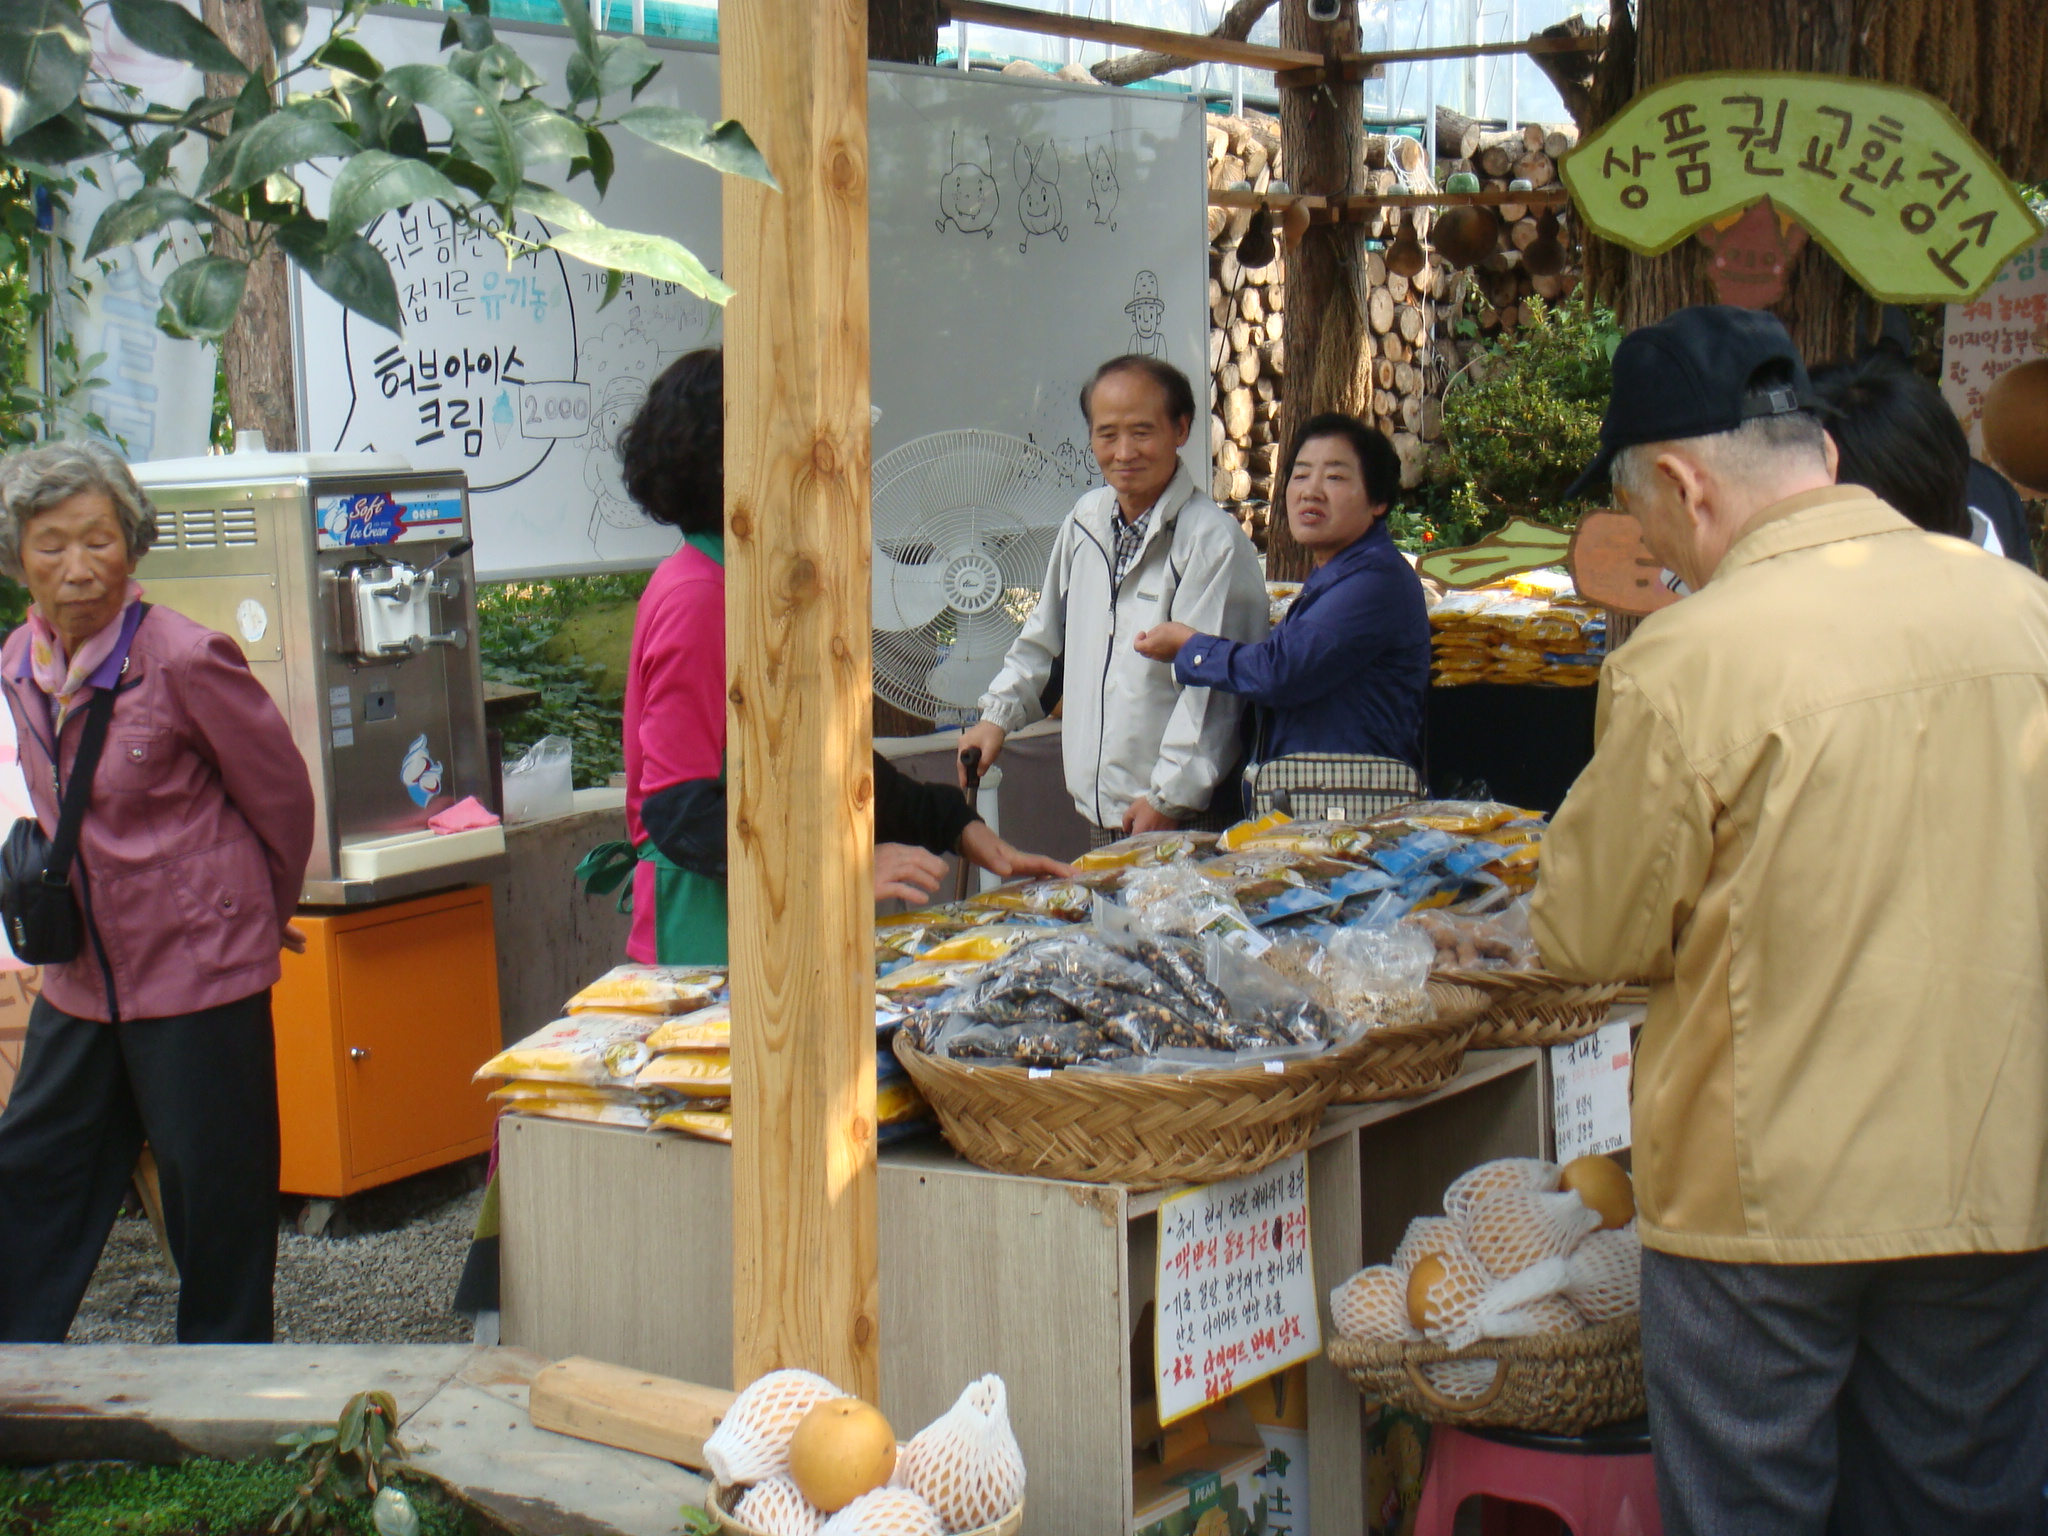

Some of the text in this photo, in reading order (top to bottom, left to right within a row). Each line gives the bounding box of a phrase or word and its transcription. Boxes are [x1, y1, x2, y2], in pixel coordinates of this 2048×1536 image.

[480, 271, 548, 324] 유기농
[373, 345, 525, 398] 허브아이스
[524, 394, 589, 425] 2000
[416, 396, 483, 457] 크림
[350, 495, 386, 523] Soft
[350, 523, 363, 539] Ice
[363, 522, 389, 539] Cream
[1194, 1481, 1217, 1505] PEAR
